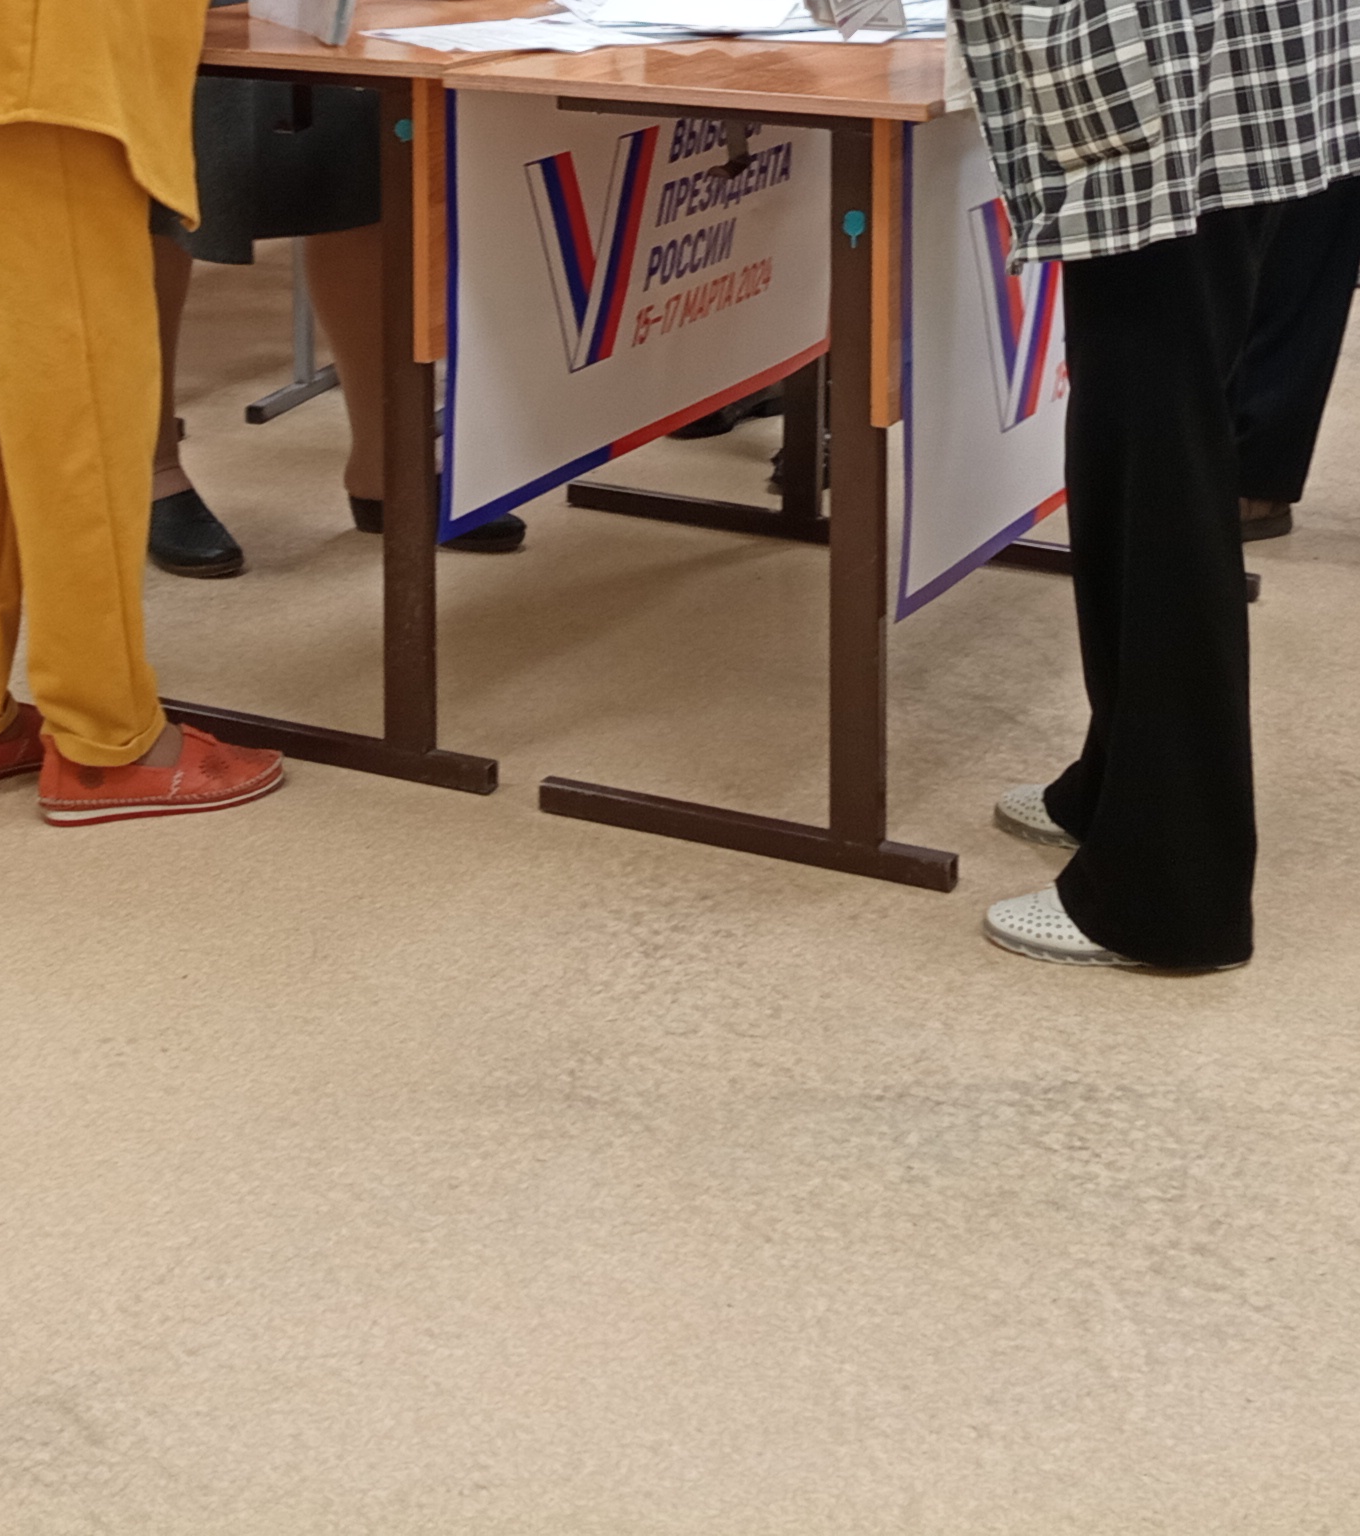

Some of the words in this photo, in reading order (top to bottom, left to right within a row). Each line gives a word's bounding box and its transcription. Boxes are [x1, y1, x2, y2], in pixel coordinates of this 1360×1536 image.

[669, 117, 762, 163] ВЫБ
[643, 217, 737, 292] РОССИИ
[679, 271, 736, 327] МАРТА
[735, 256, 772, 303] 2024
